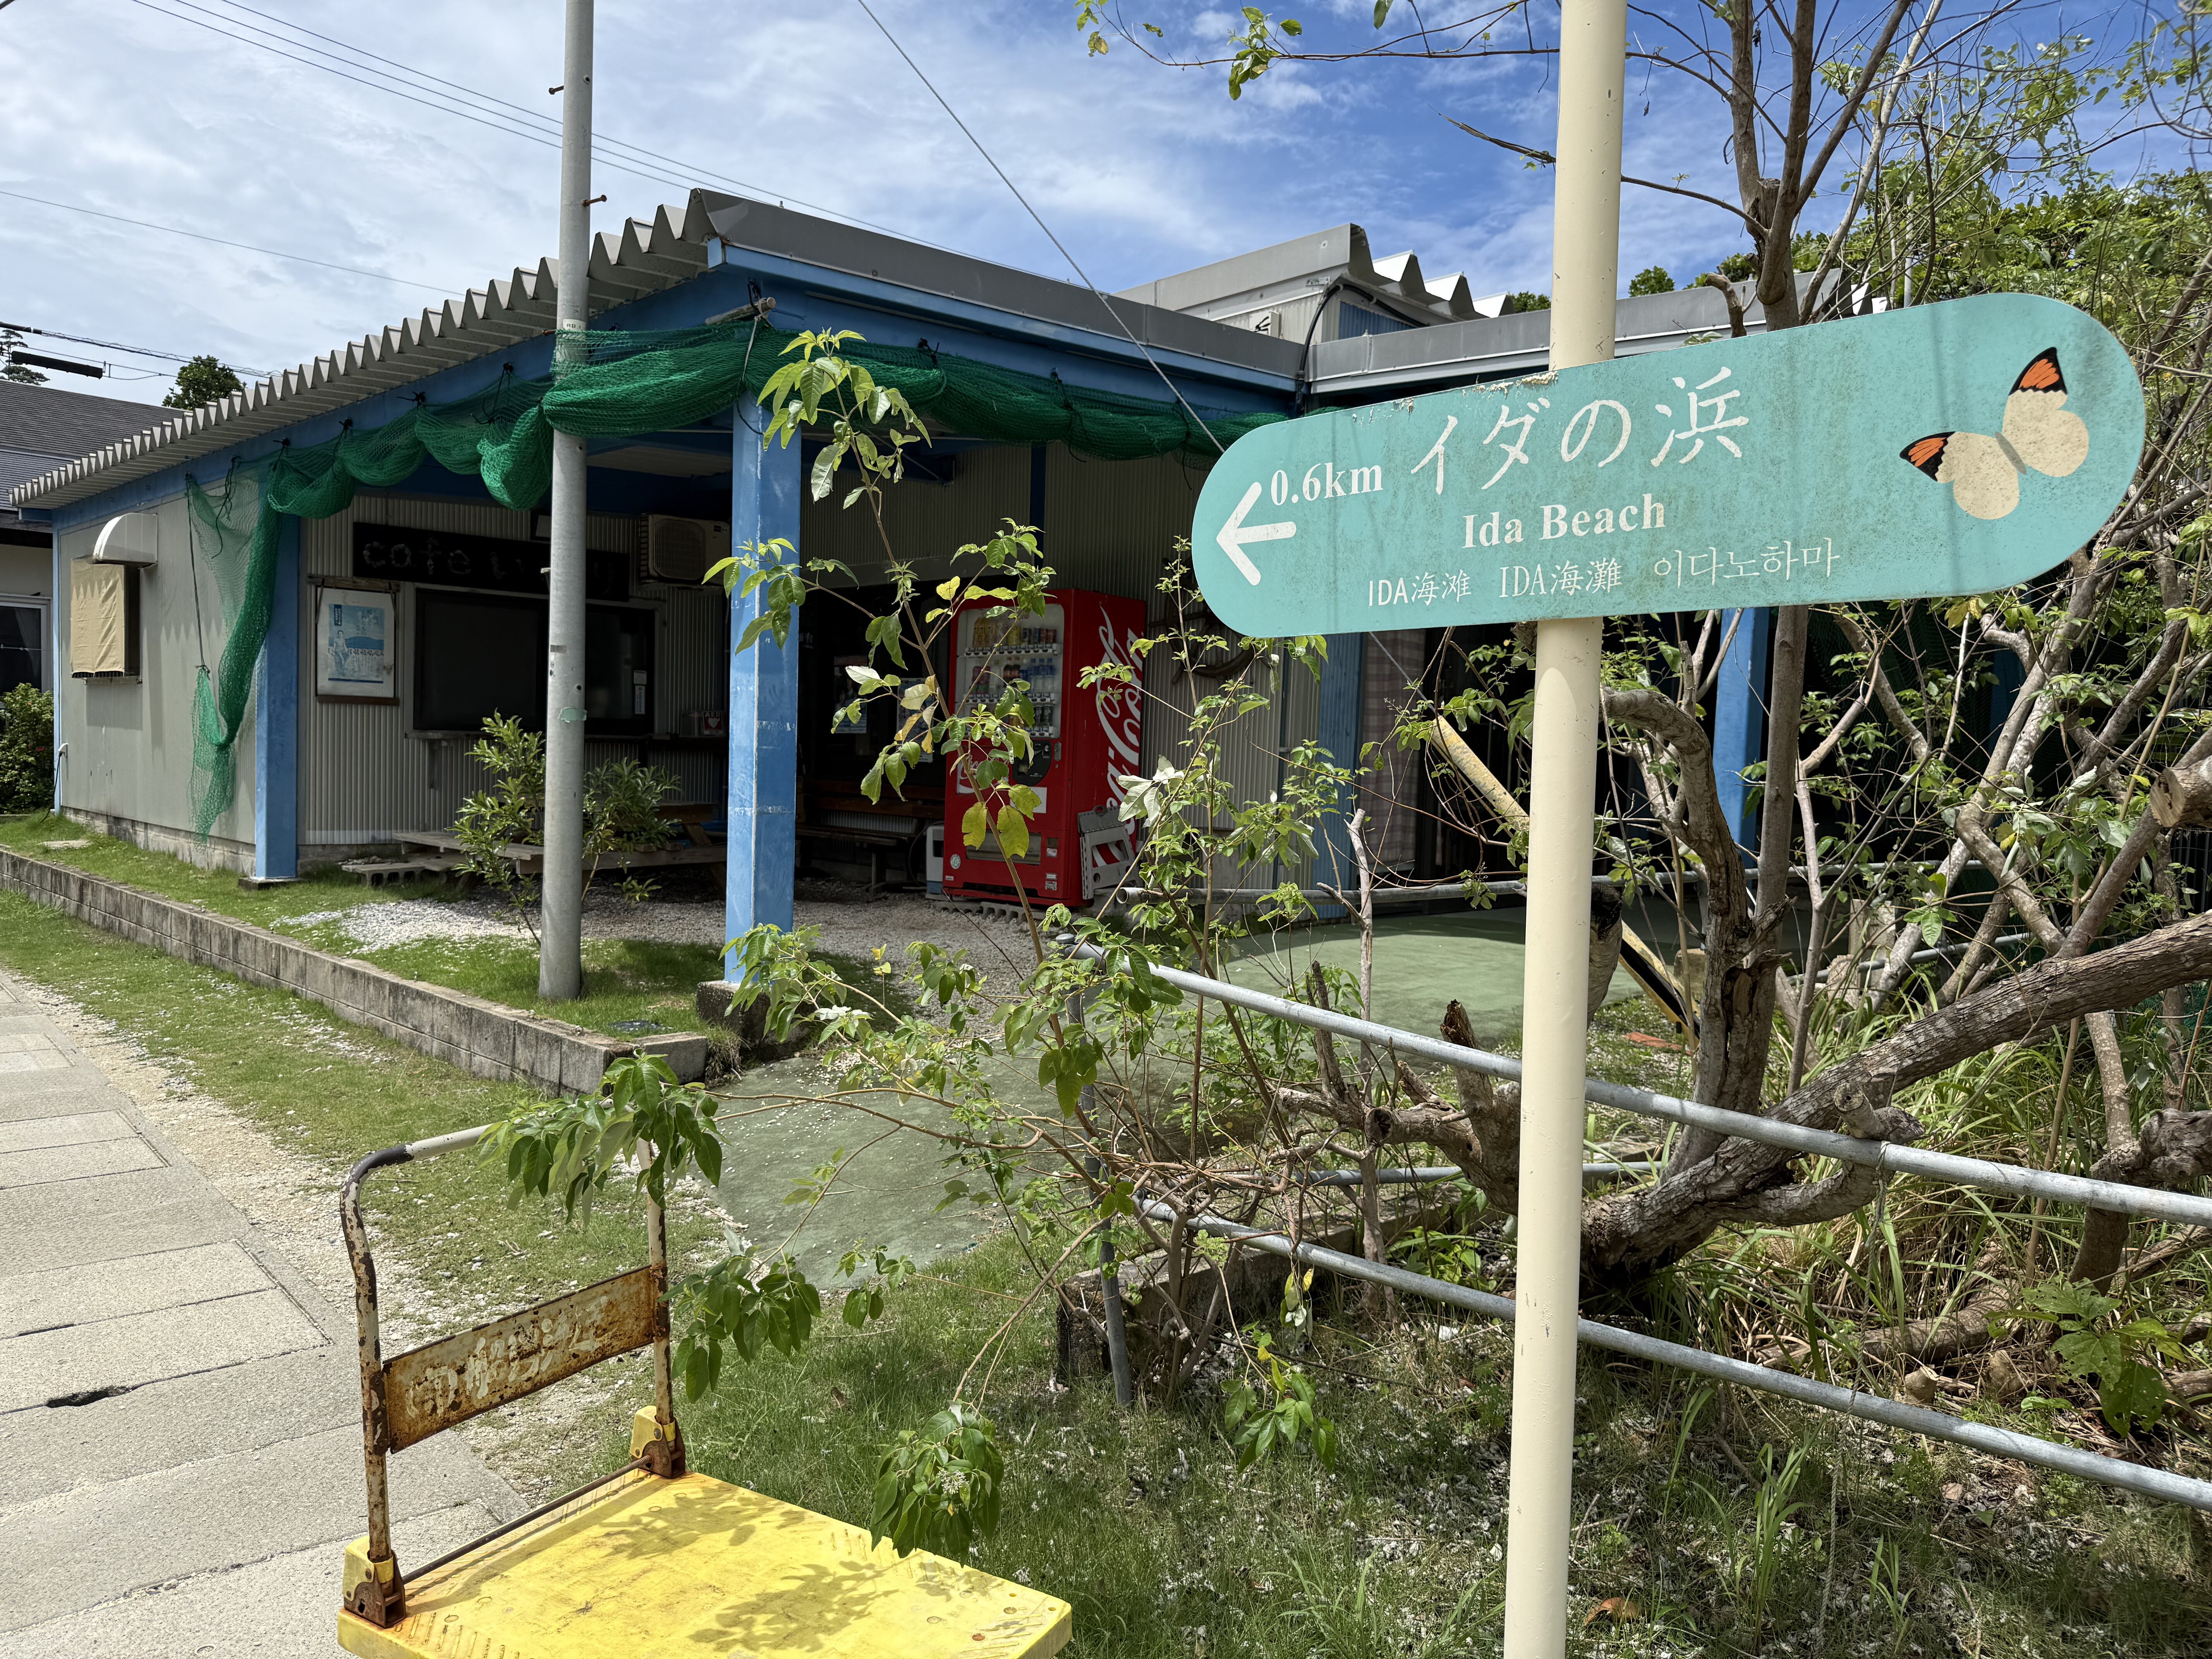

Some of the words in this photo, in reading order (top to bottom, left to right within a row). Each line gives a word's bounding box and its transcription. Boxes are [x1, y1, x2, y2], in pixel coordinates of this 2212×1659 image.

[1411, 366, 1749, 495] イダの浜
[1270, 462, 1383, 506] 0.6km
[1462, 514, 1524, 548] Ida
[1539, 493, 1666, 540] Beach
[1368, 569, 1472, 606] IDA海滩
[1499, 557, 1623, 598] IDA海灘
[1654, 537, 1840, 588] 이다노하마
